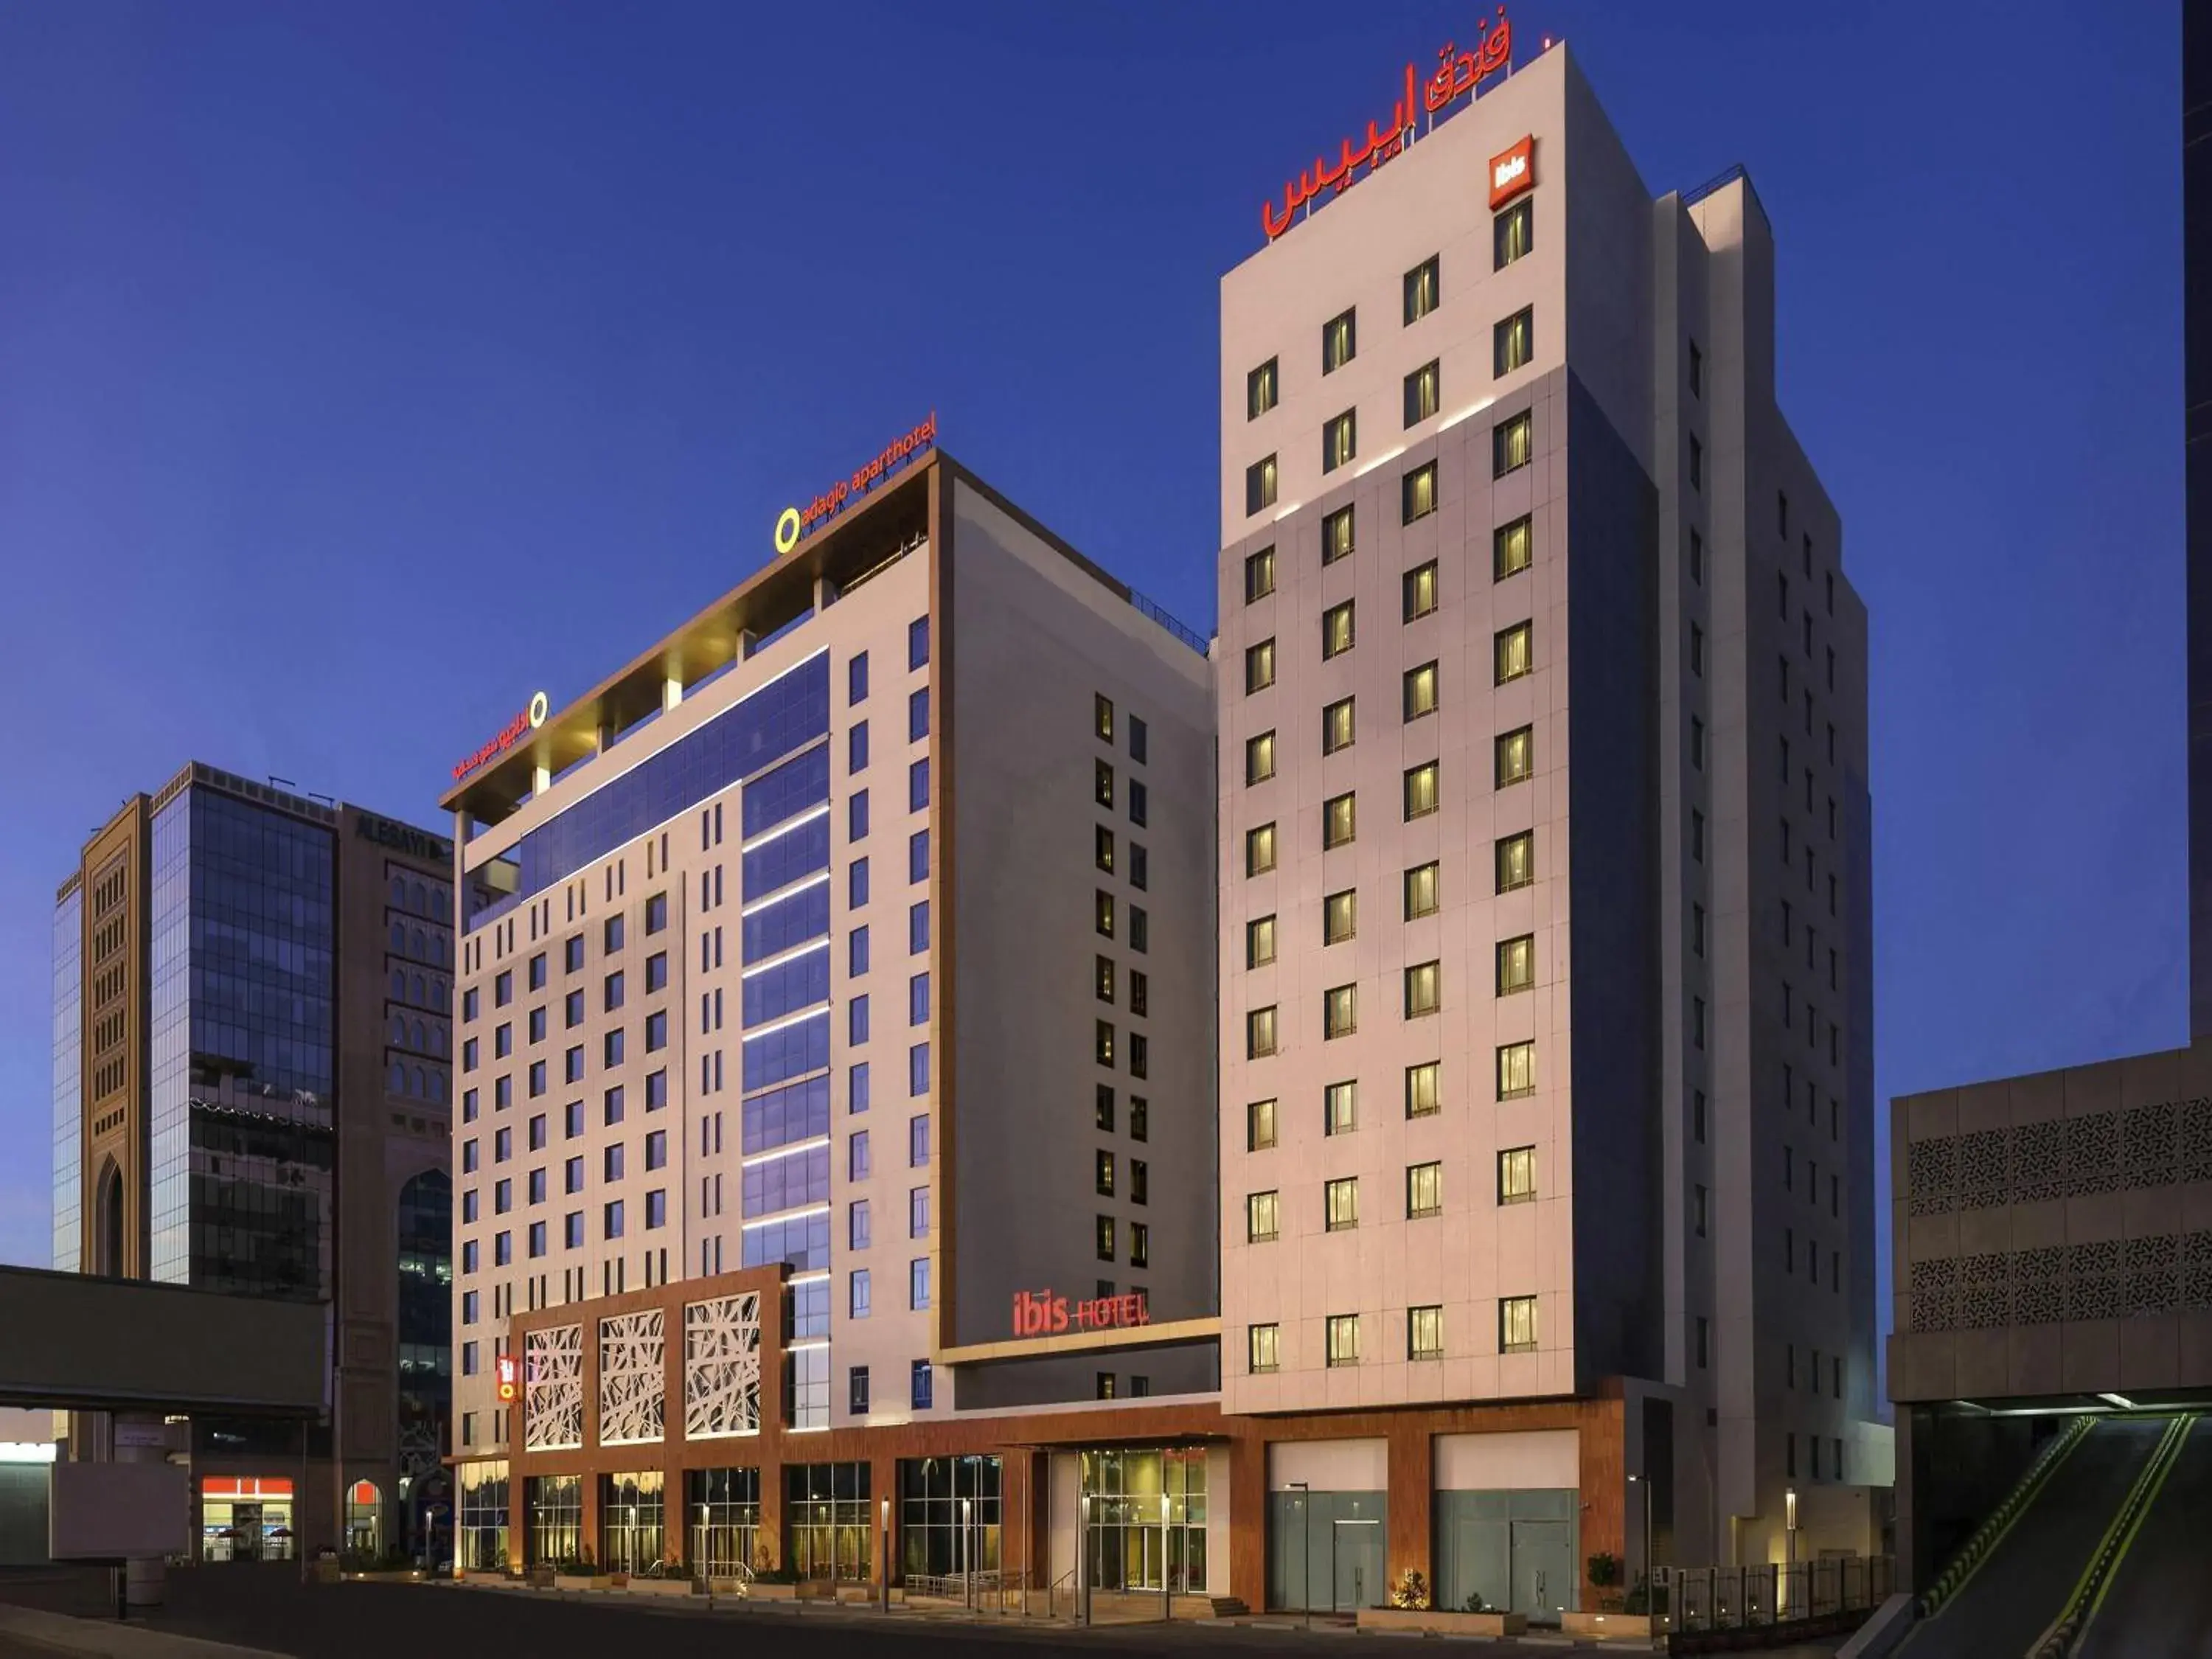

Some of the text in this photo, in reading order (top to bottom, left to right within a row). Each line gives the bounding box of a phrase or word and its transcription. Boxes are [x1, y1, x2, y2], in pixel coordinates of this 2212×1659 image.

[1424, 6, 1512, 114] فندق
[801, 409, 937, 526] adagio aparthotel
[1013, 1288, 1150, 1336] ibis HOTEL
